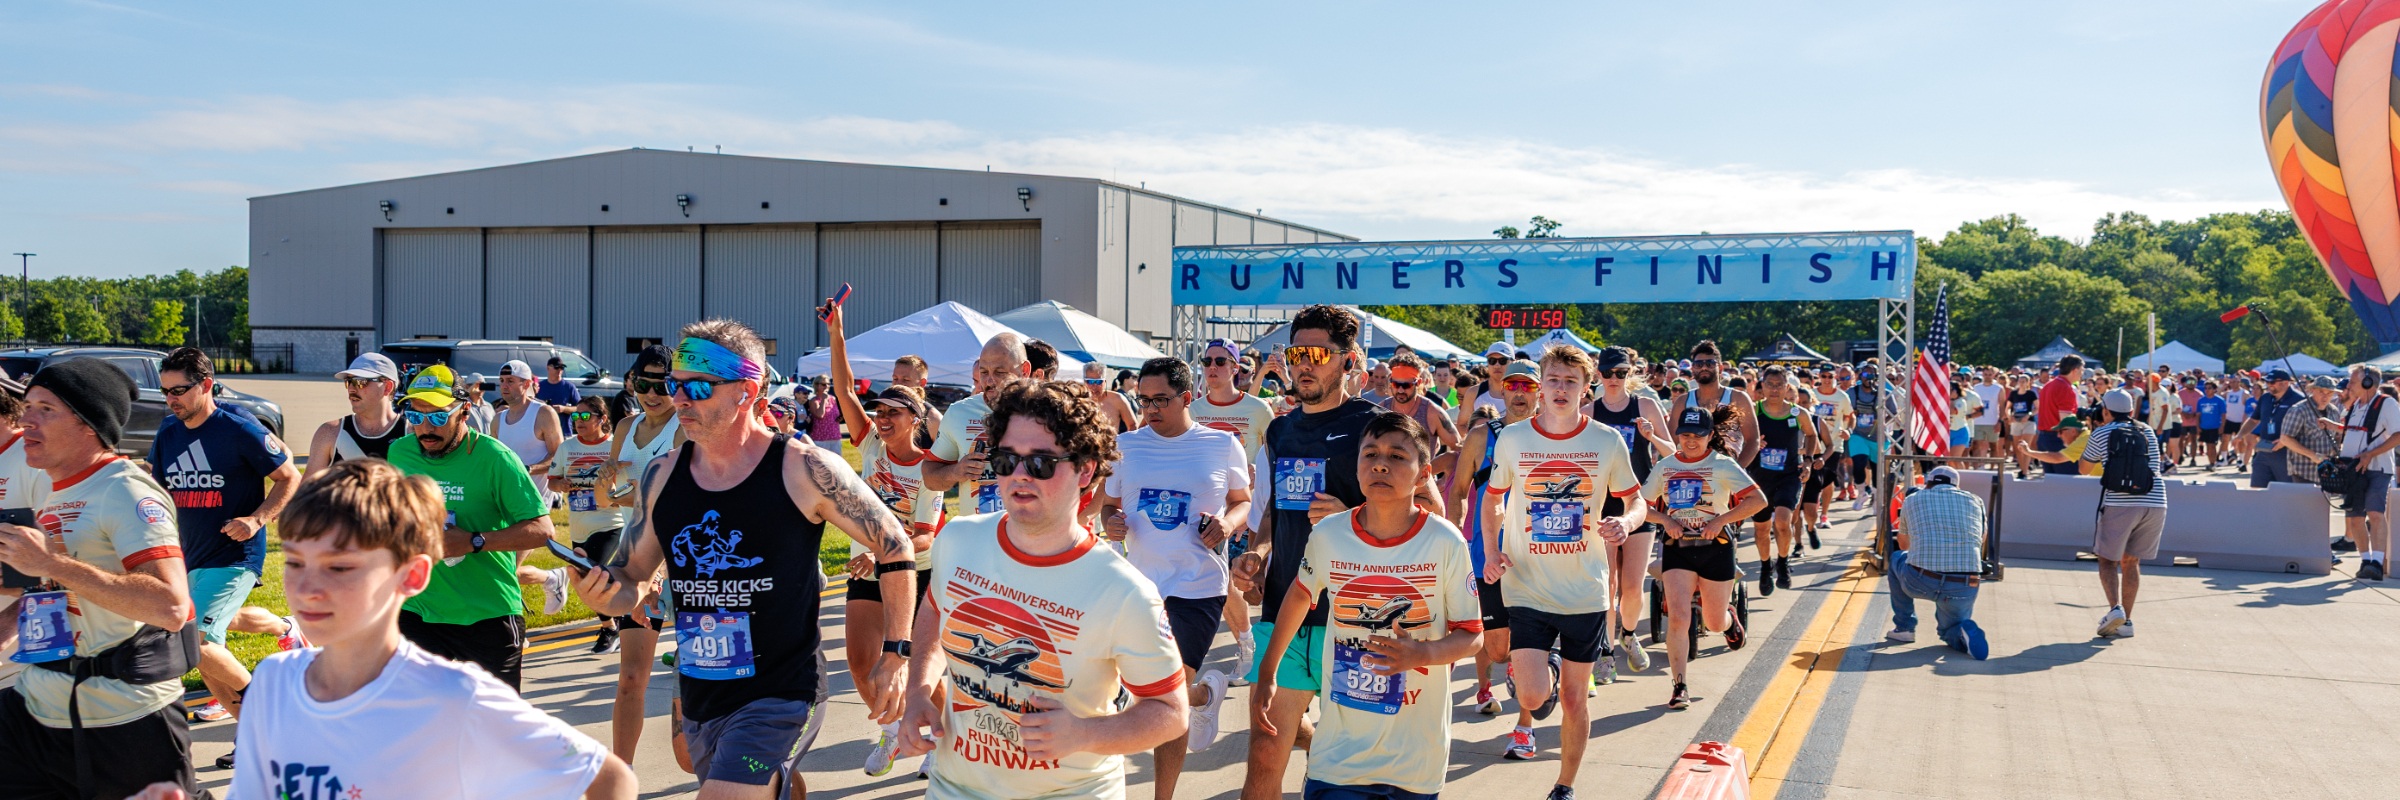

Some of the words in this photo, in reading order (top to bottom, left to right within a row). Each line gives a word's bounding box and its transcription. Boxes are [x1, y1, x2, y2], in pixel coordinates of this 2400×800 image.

[1181, 259, 1519, 291] RUNNERS
[1595, 251, 1897, 287] FINISH
[1546, 452, 1599, 460] ANNIVERSARY
[165, 470, 225, 489] adidas
[1286, 475, 1313, 493] 697
[1675, 489, 1693, 499] 116
[573, 498, 589, 508] 439
[1154, 503, 1172, 517] 43
[1543, 516, 1571, 530] 625
[1529, 541, 1589, 555] RUNWAY
[1330, 560, 1361, 572] TENTH
[1362, 562, 1437, 574] ANNIVERSARY
[671, 579, 719, 593] CROSS
[722, 577, 774, 593] KICKS
[683, 593, 752, 607] FITNESS
[954, 566, 990, 590] TENTH
[990, 582, 1085, 621] ANNIVERSARY
[692, 635, 729, 658] 491
[735, 667, 750, 677] 491
[1346, 668, 1387, 694] 528
[1384, 704, 1397, 713] 528
[974, 709, 1018, 742] 2025
[968, 728, 1000, 748] RUN
[954, 735, 1060, 771] RUNWAY
[742, 755, 769, 770] HYROX
